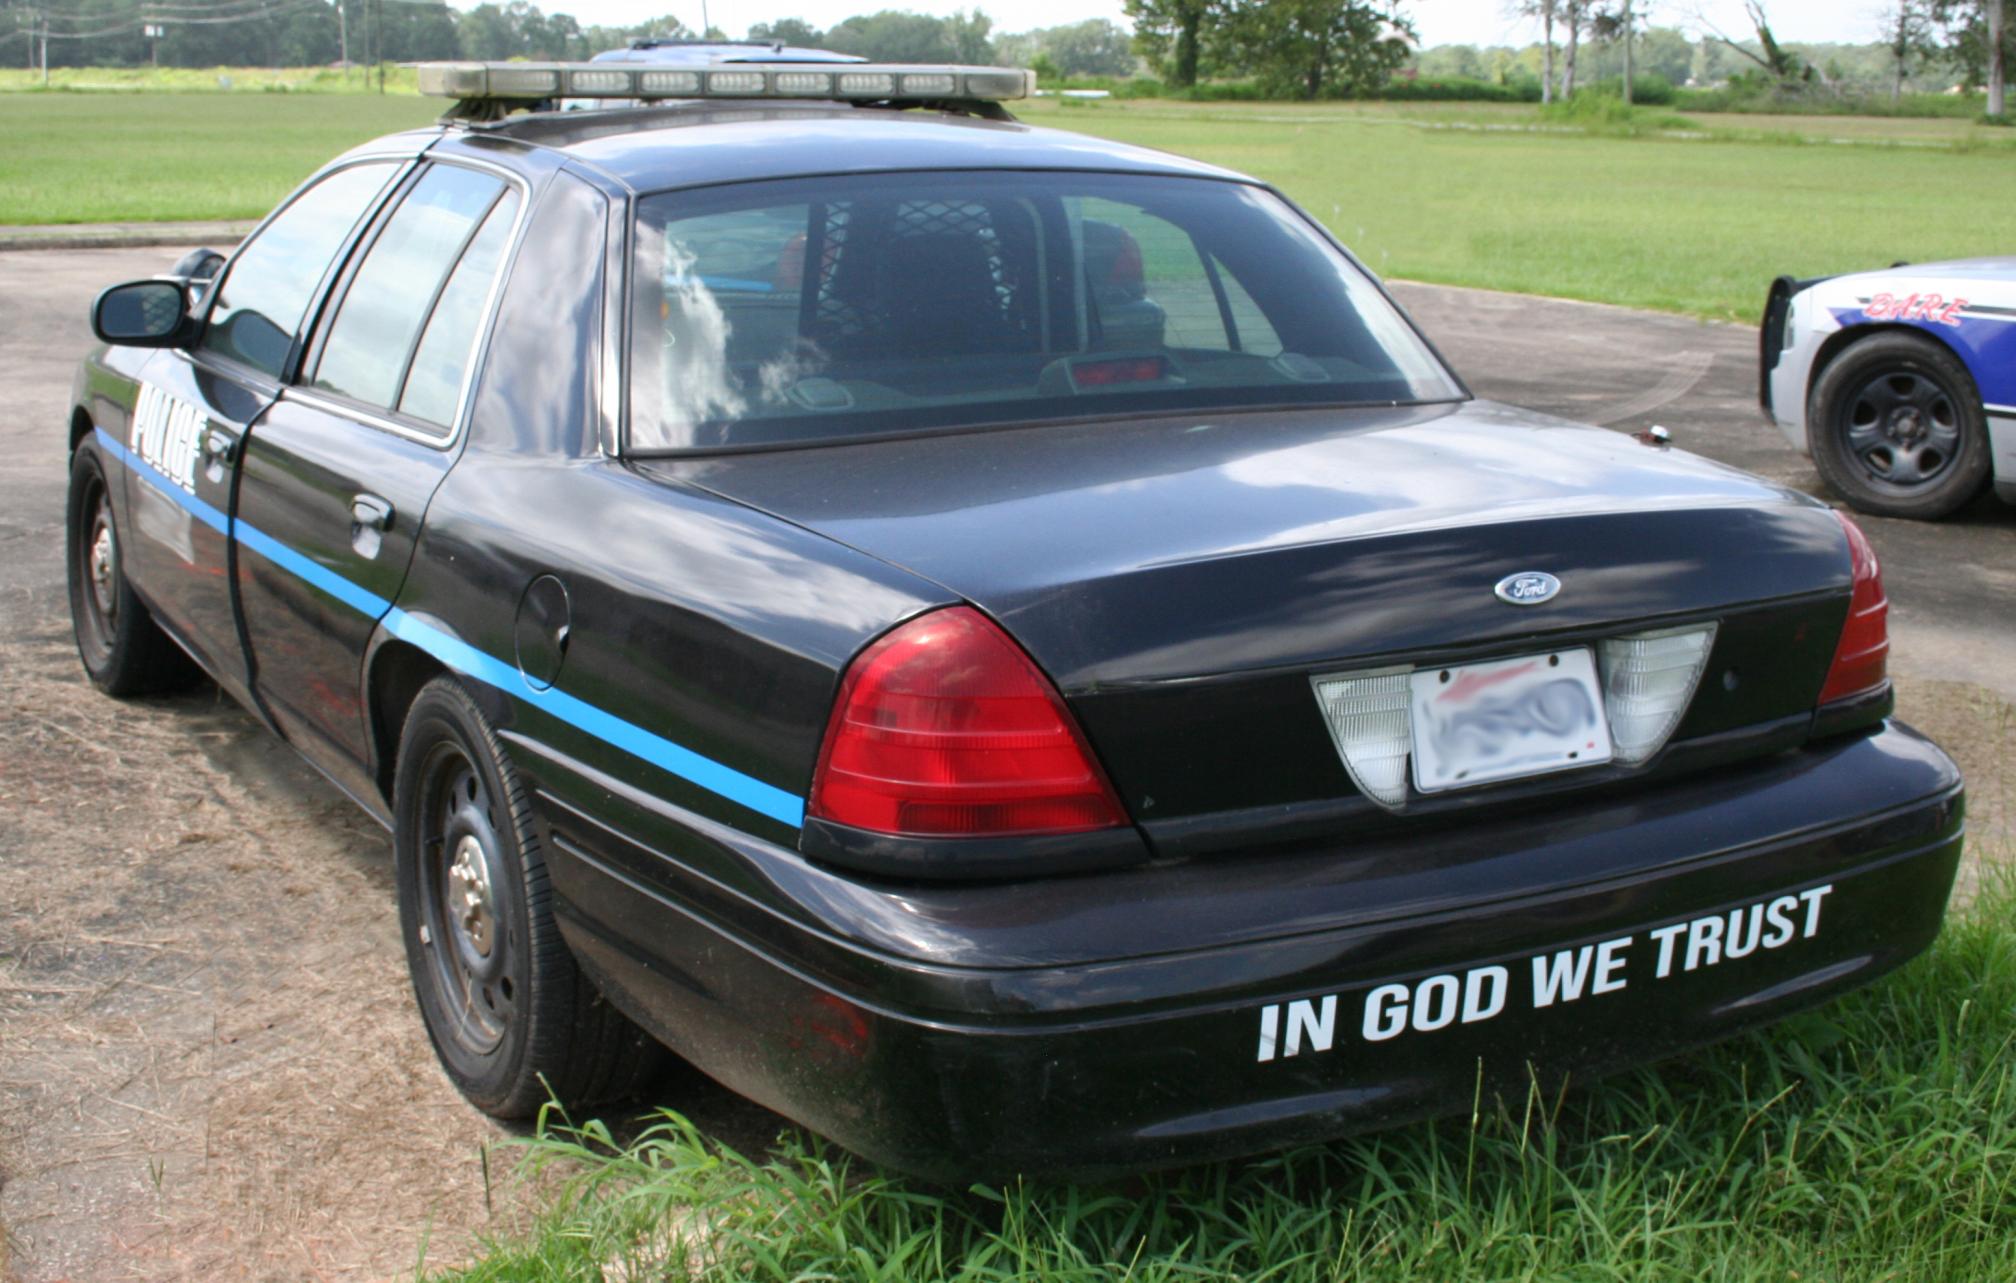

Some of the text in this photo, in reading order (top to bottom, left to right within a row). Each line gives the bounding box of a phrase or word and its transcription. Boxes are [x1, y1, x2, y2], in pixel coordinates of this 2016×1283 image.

[1863, 292, 1968, 326] DARE
[130, 380, 209, 495] POLICE
[1256, 884, 1832, 1063] IN GOD WE TRUST
